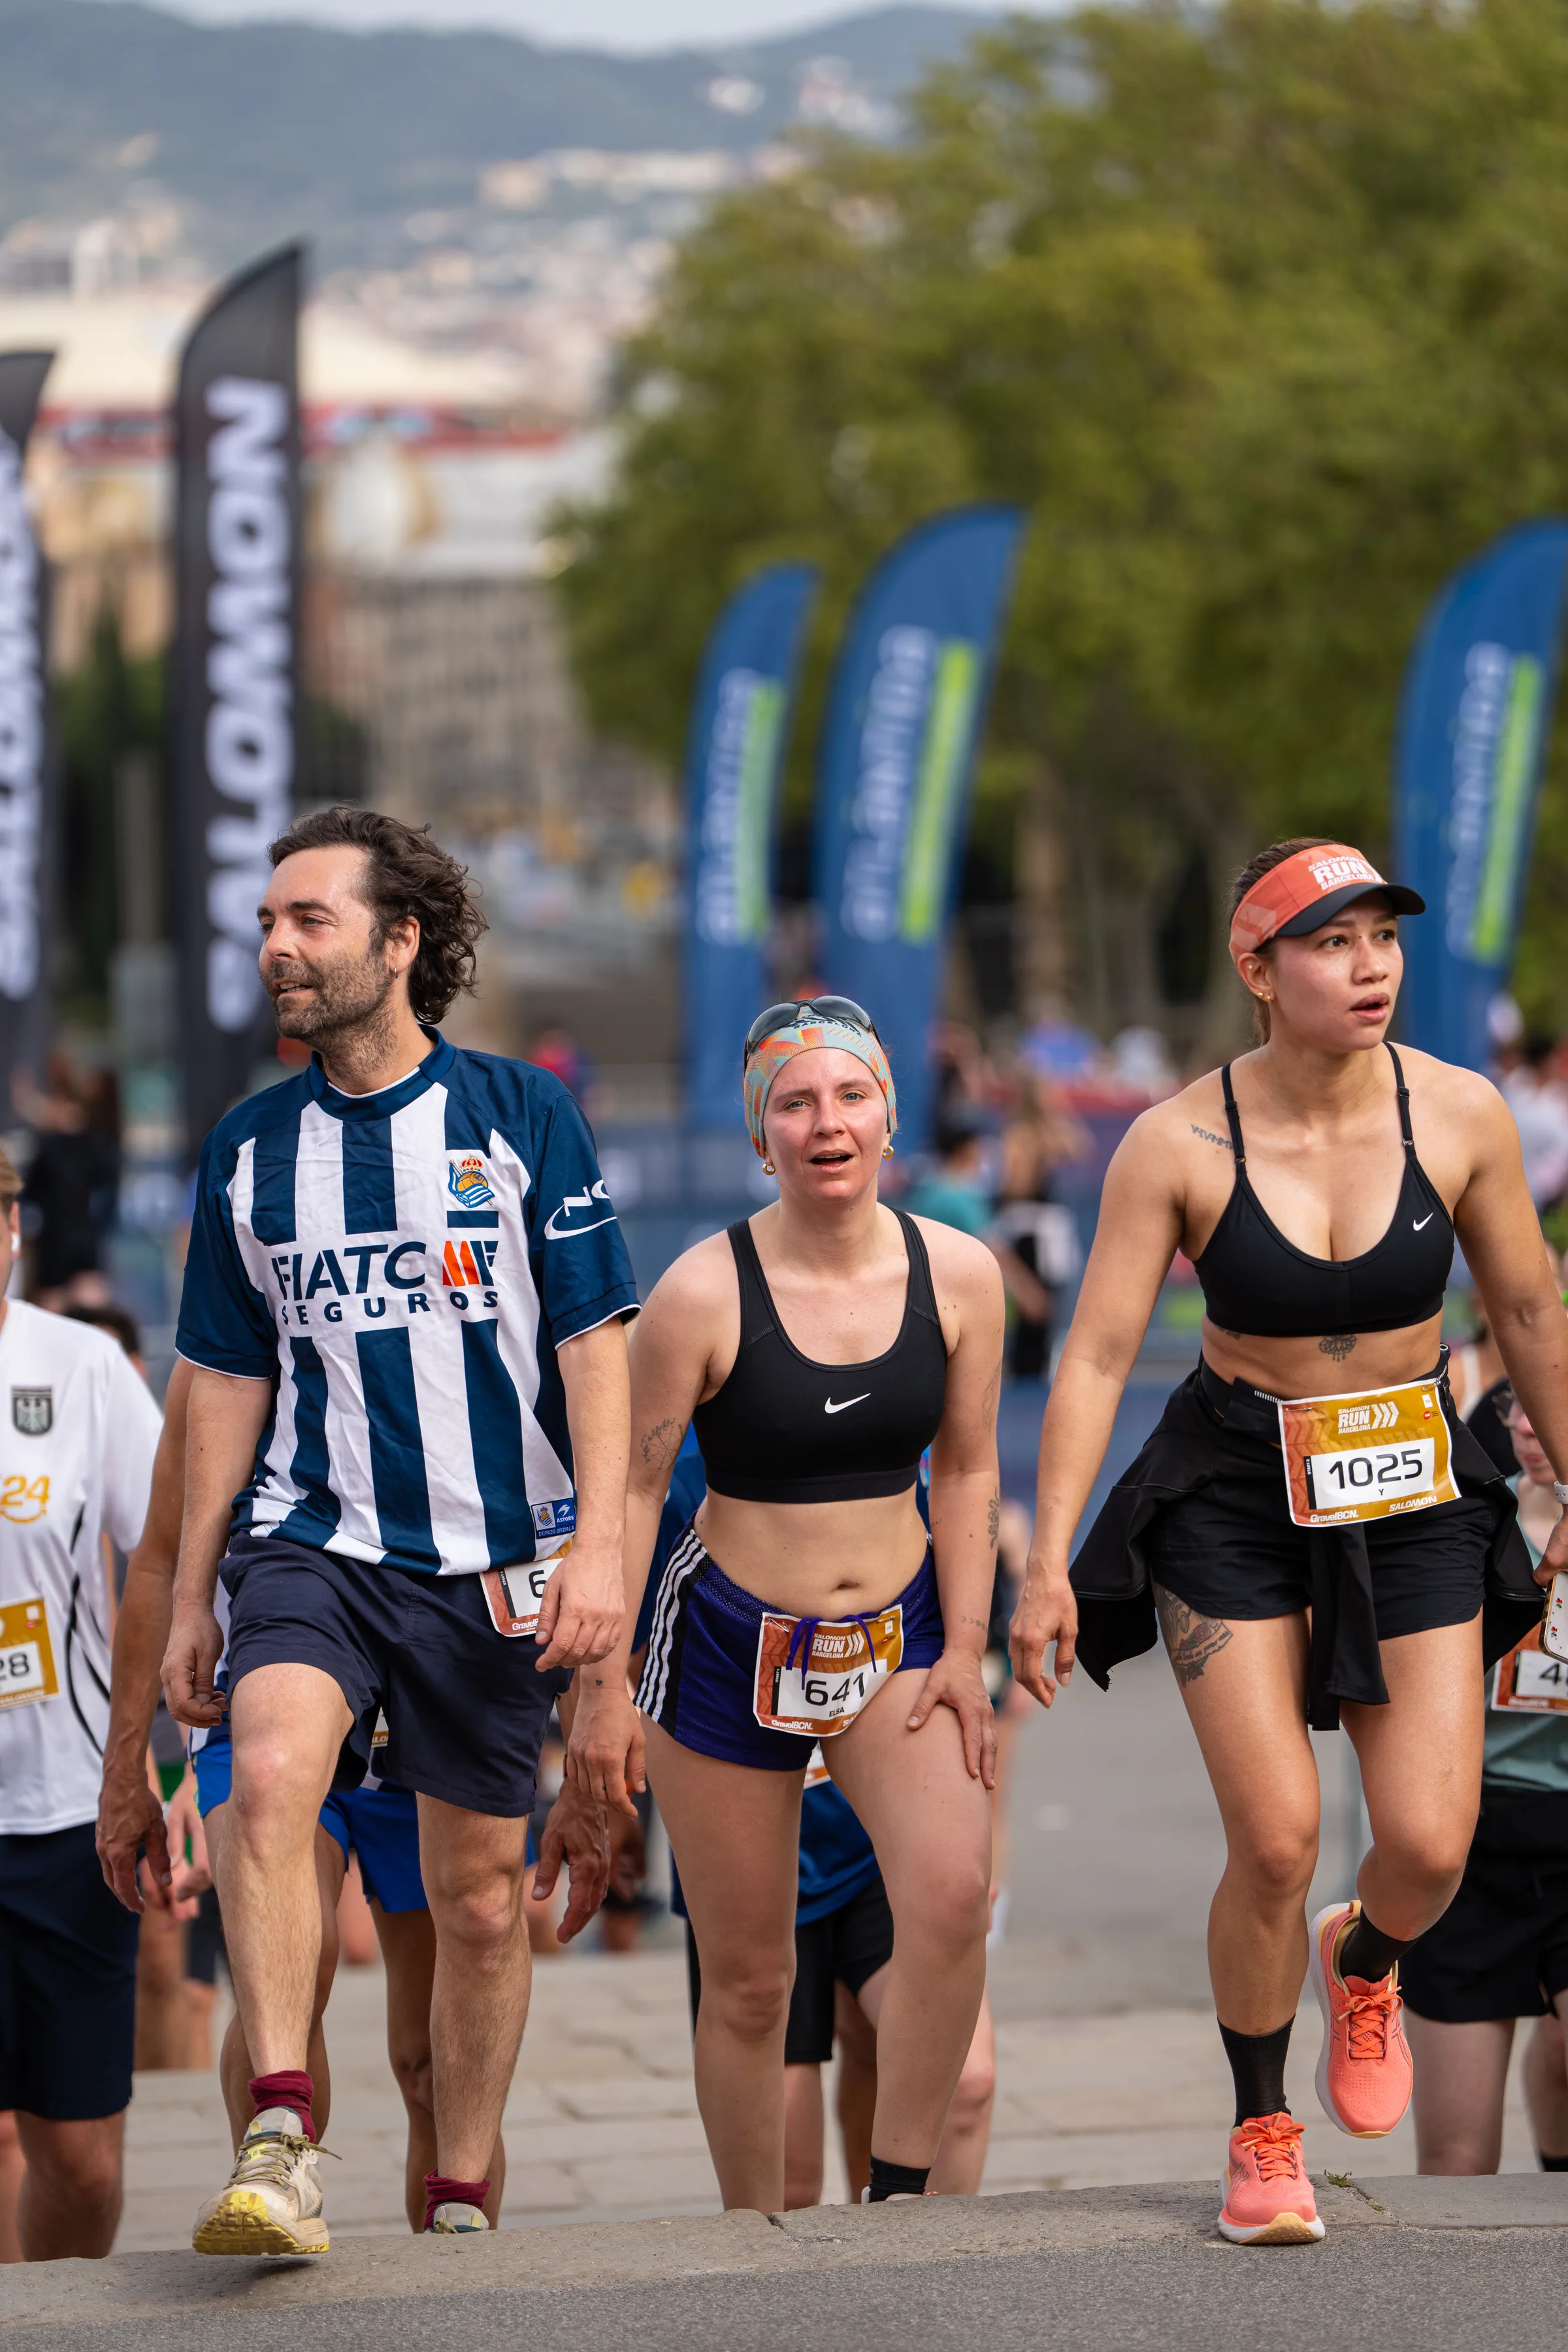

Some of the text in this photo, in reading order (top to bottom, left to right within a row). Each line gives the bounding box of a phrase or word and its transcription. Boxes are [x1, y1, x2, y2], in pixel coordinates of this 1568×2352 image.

[1308, 856, 1360, 872] SALOMON
[1313, 861, 1368, 884] RUN
[1320, 874, 1374, 890] BARCELONA
[793, 1021, 861, 1037] BARCELONA
[271, 1241, 427, 1301] FIATC
[282, 1291, 498, 1325] SEGUROS
[1338, 1405, 1370, 1414] SALOMON
[1338, 1410, 1370, 1428] RUN
[1338, 1424, 1371, 1434] BARCELONA
[1328, 1448, 1422, 1489] 1025
[1389, 1495, 1437, 1512] SALOMON
[812, 1638, 845, 1653] RUN
[805, 1672, 865, 1707] 641
[829, 1707, 845, 1717] ELSA
